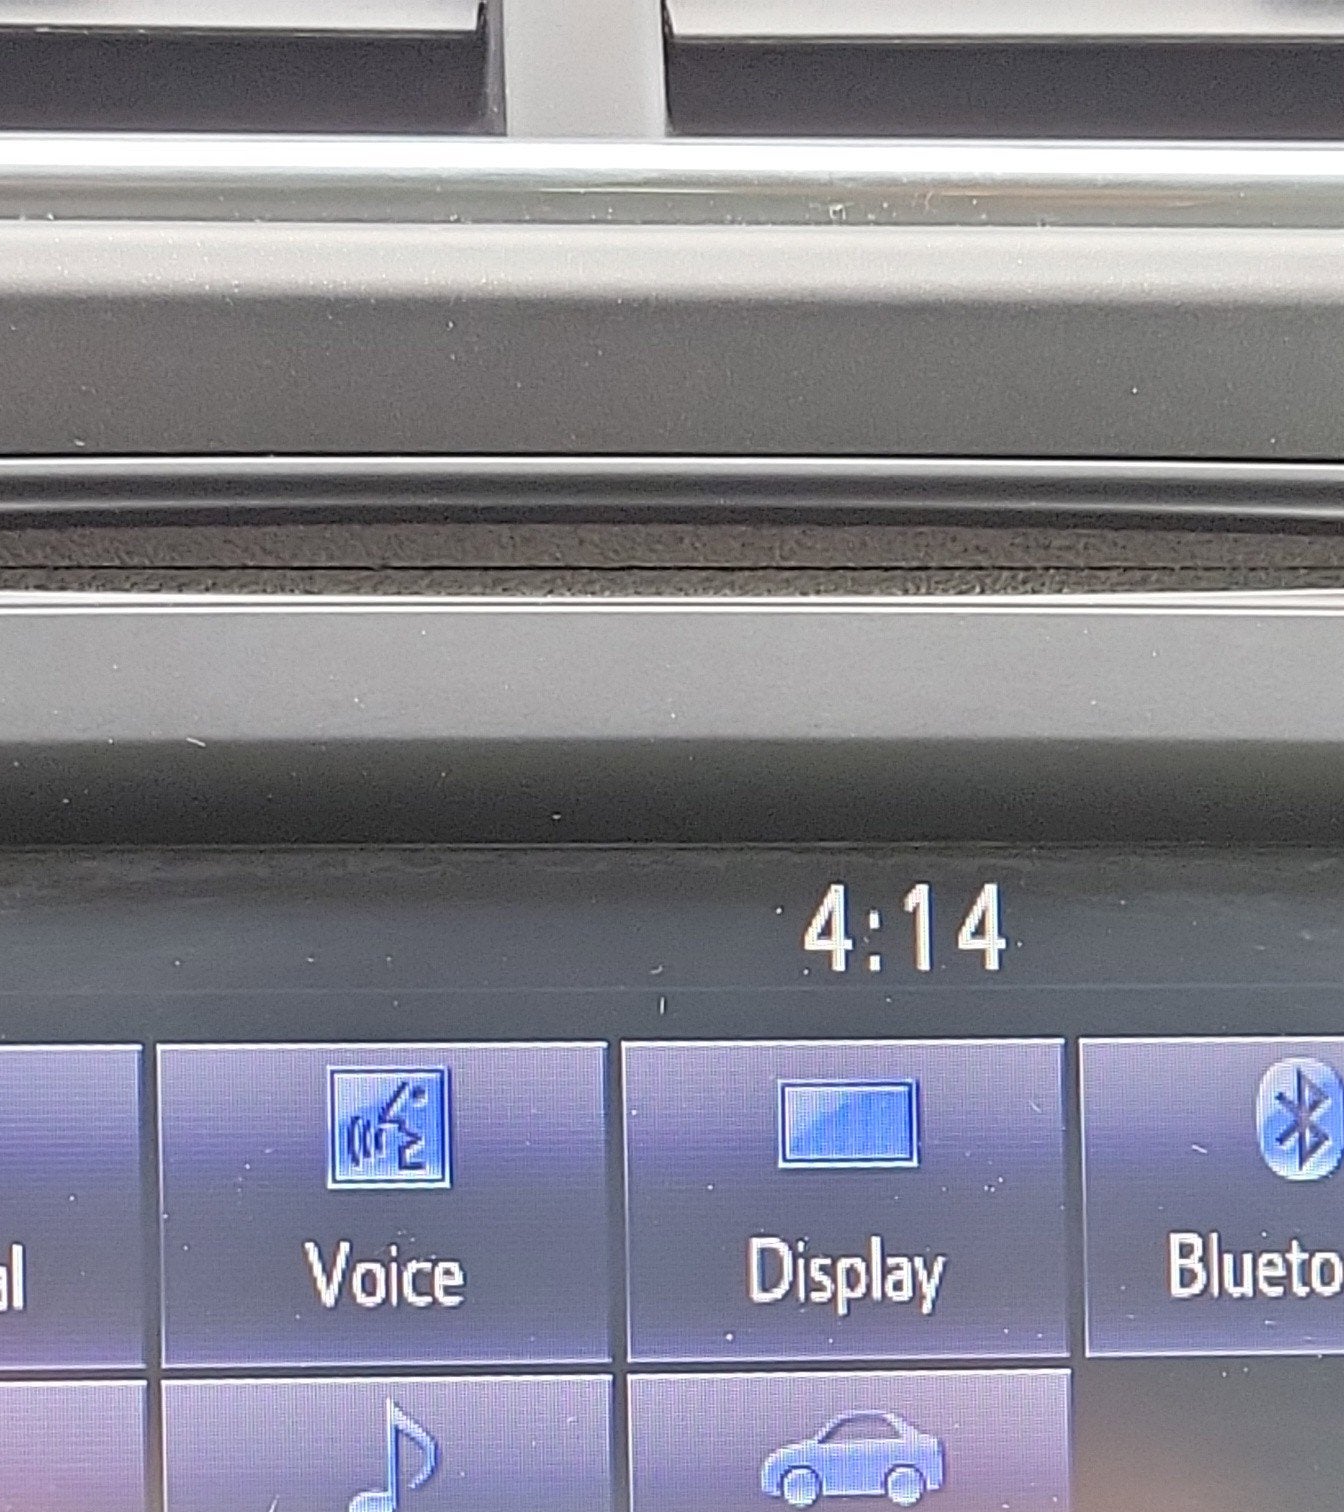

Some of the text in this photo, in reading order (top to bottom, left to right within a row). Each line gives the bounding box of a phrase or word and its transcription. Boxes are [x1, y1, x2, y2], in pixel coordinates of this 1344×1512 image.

[803, 882, 1008, 973] 4:14
[304, 1240, 466, 1308] Voice
[746, 1237, 946, 1315] Display
